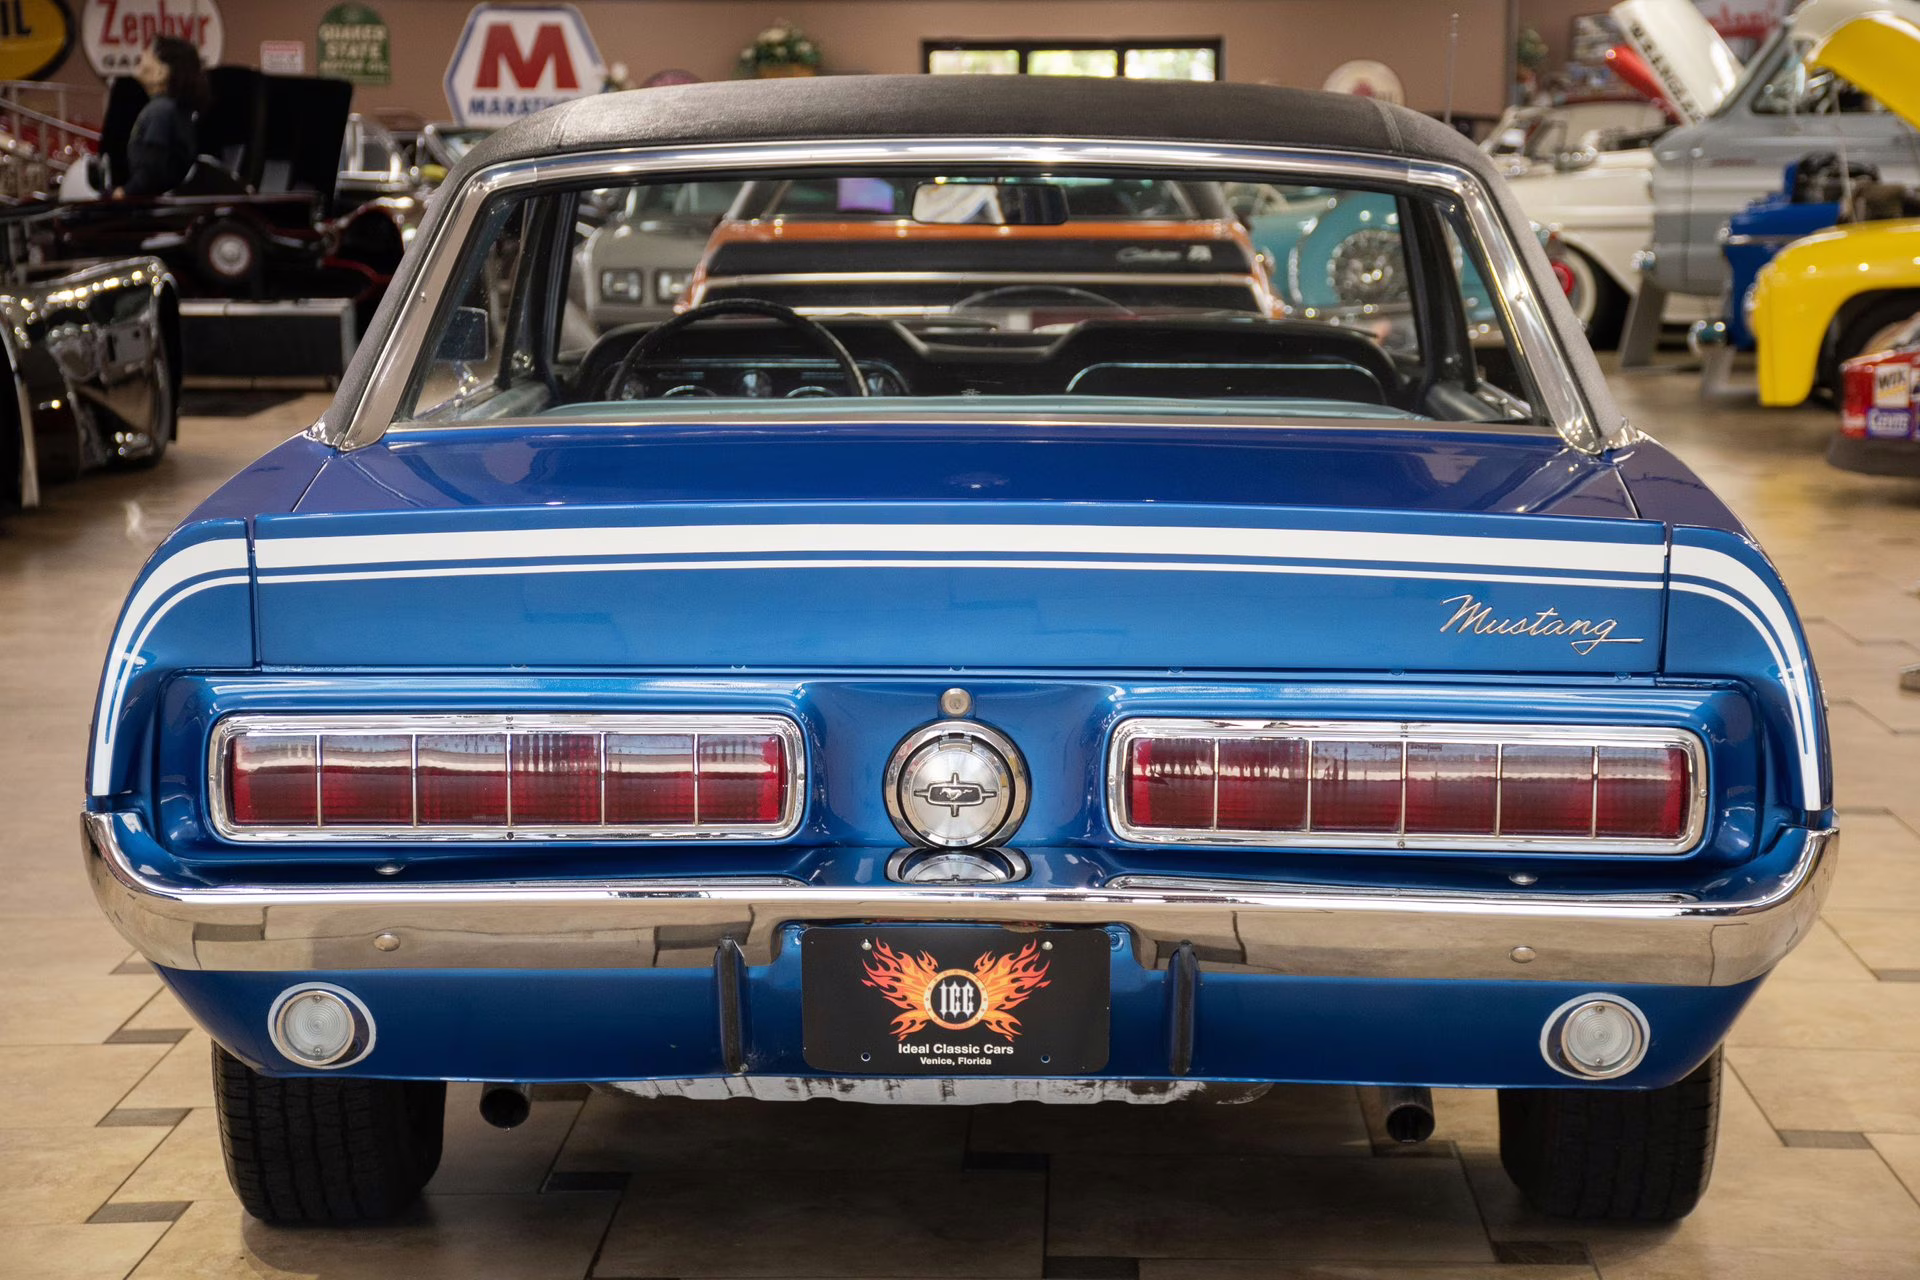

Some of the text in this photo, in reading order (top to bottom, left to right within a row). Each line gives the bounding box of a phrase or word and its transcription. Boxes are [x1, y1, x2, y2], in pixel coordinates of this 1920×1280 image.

[97, 0, 210, 49] Zephyr
[325, 41, 381, 59] STATE
[475, 23, 579, 90] M
[1440, 594, 1645, 656] Mustang
[898, 1043, 1014, 1054] Ideal Classic Cars
[920, 1056, 992, 1066] Venice, Florida
